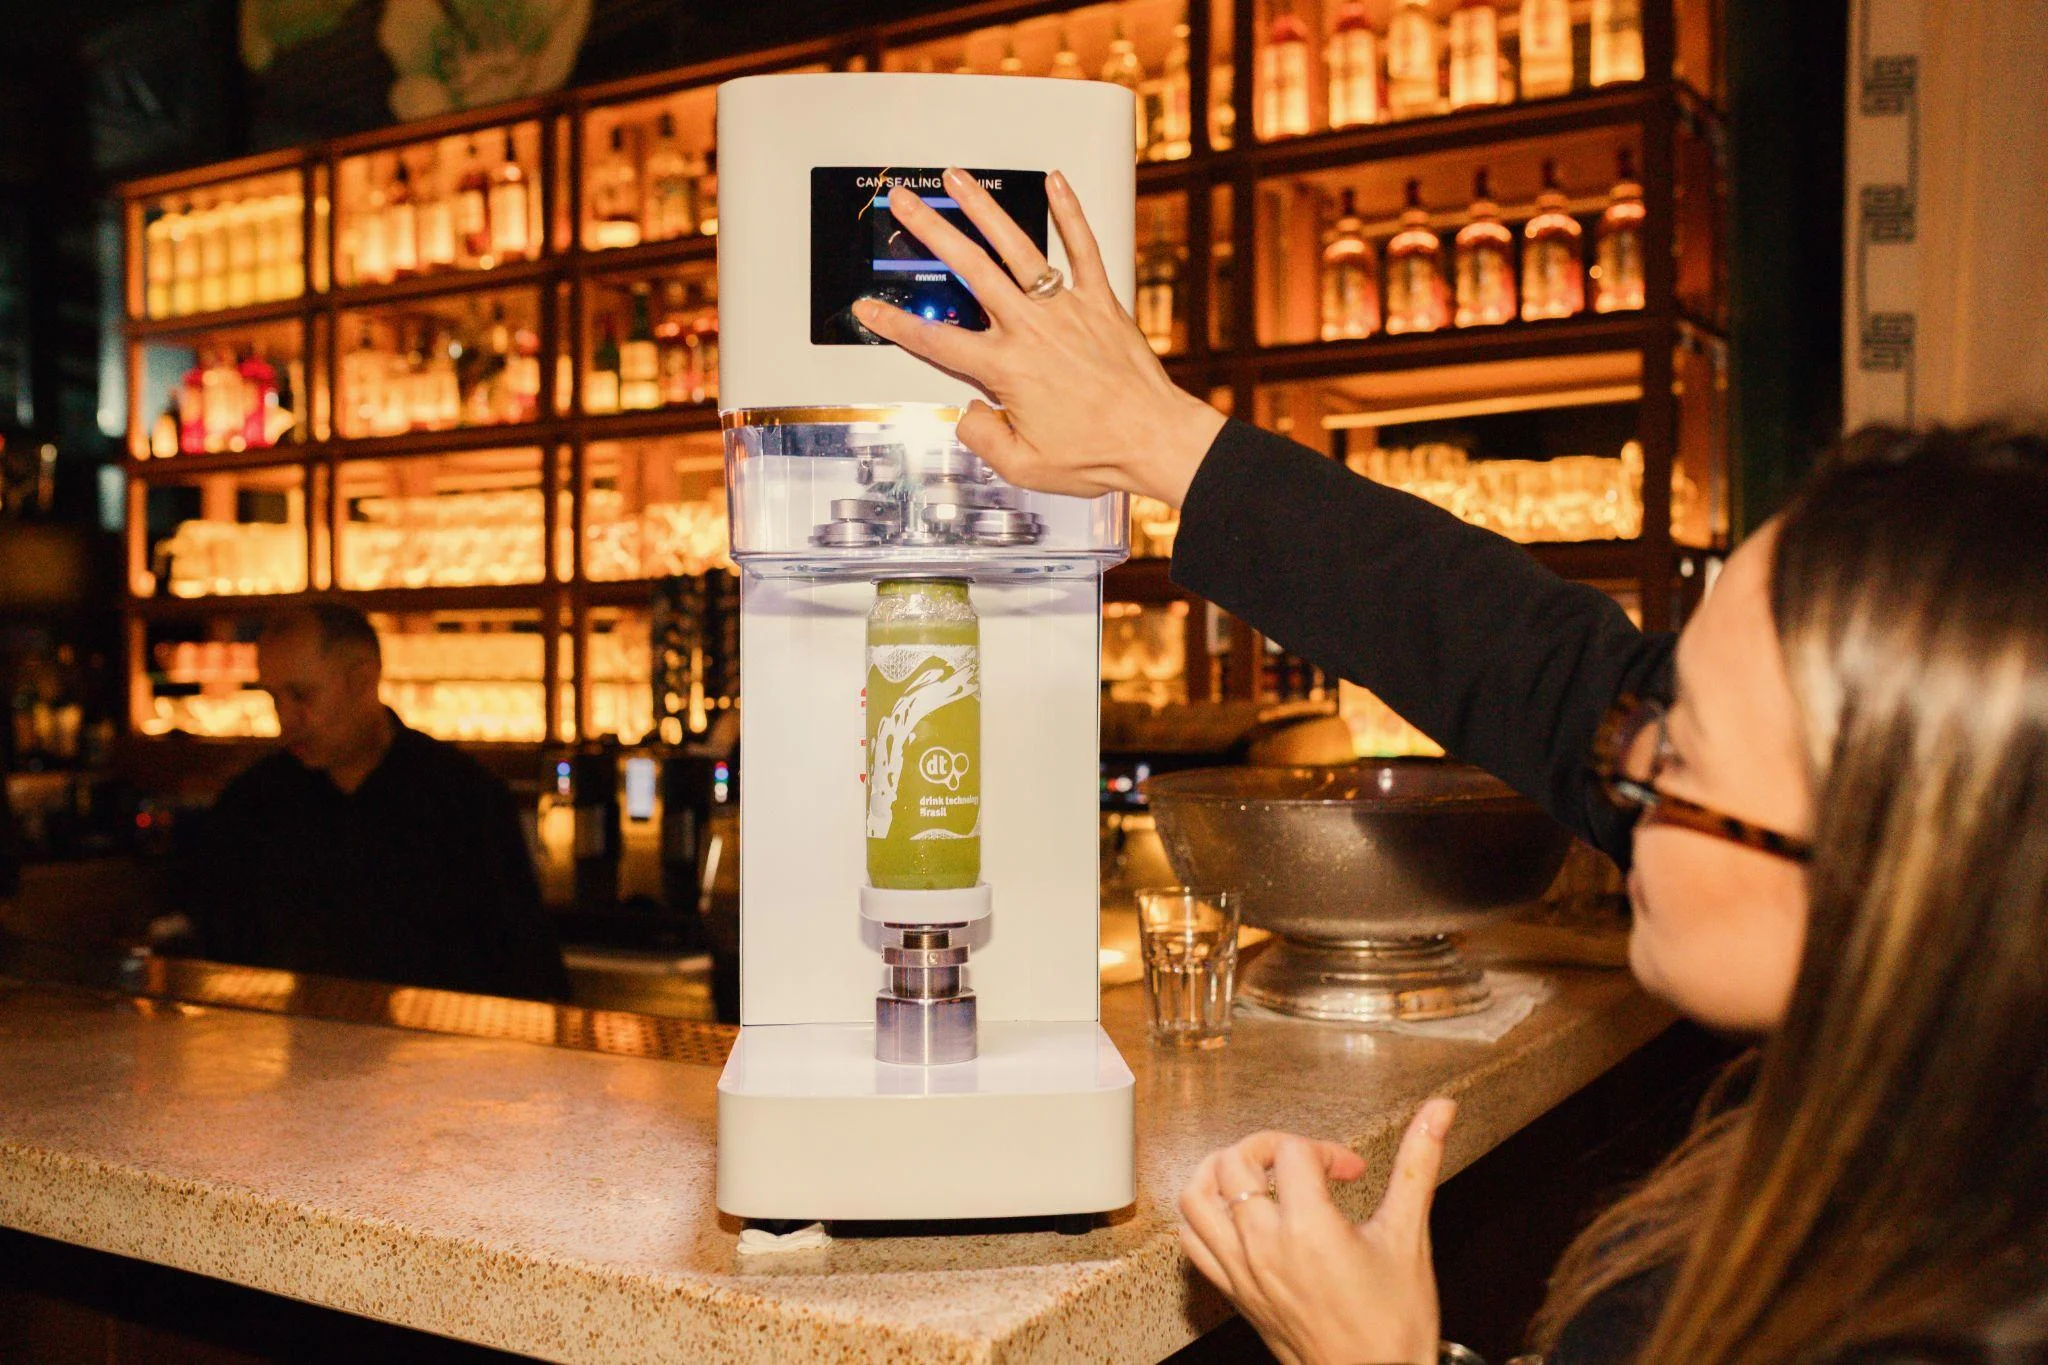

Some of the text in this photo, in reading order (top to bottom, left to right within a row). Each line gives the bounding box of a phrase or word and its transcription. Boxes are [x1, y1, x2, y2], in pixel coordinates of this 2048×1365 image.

[856, 177, 883, 188] CAN
[886, 177, 941, 188] SEALING
[926, 754, 947, 775] dt
[919, 796, 944, 806] drink
[919, 806, 947, 817] Brasil
